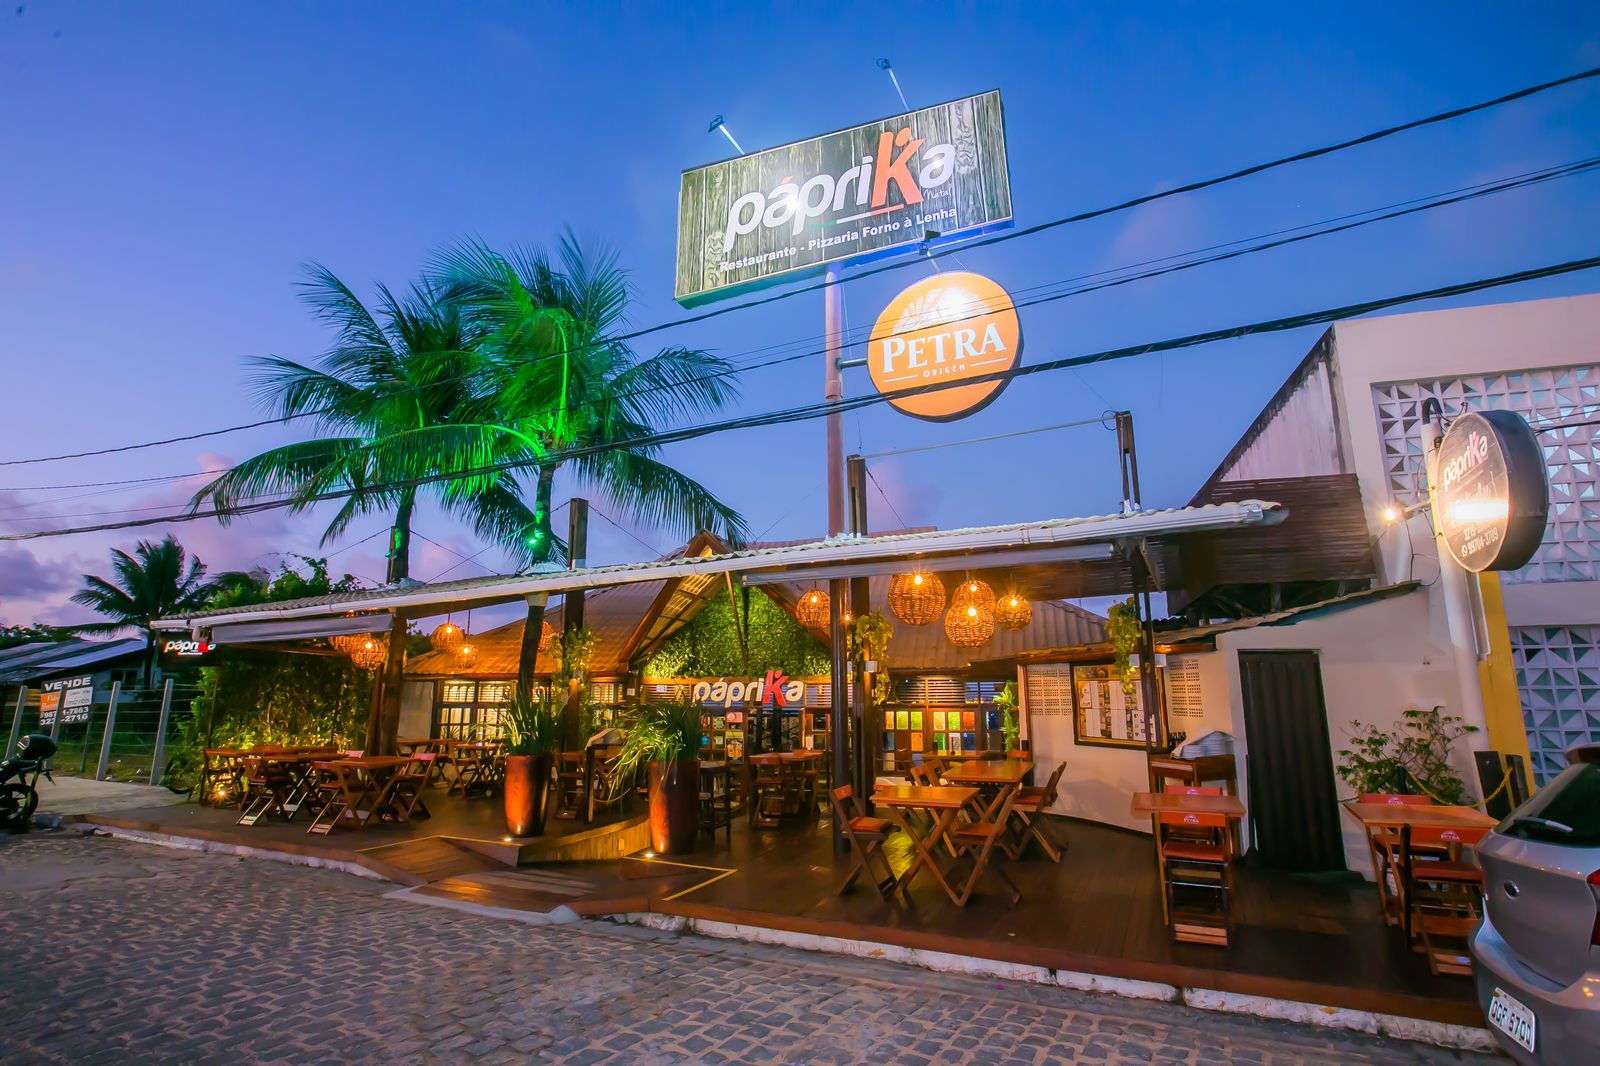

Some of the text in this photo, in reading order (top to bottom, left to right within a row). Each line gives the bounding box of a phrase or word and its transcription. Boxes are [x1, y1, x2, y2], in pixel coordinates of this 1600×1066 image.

[719, 246, 797, 273] Restaurante
[808, 230, 859, 251] Pizzaria
[863, 221, 900, 237] Forno
[904, 217, 912, 228] à
[916, 208, 956, 225] Lenha
[882, 322, 1007, 373] PETRA
[923, 364, 965, 377] ORIGEM
[44, 677, 91, 691] VENDE
